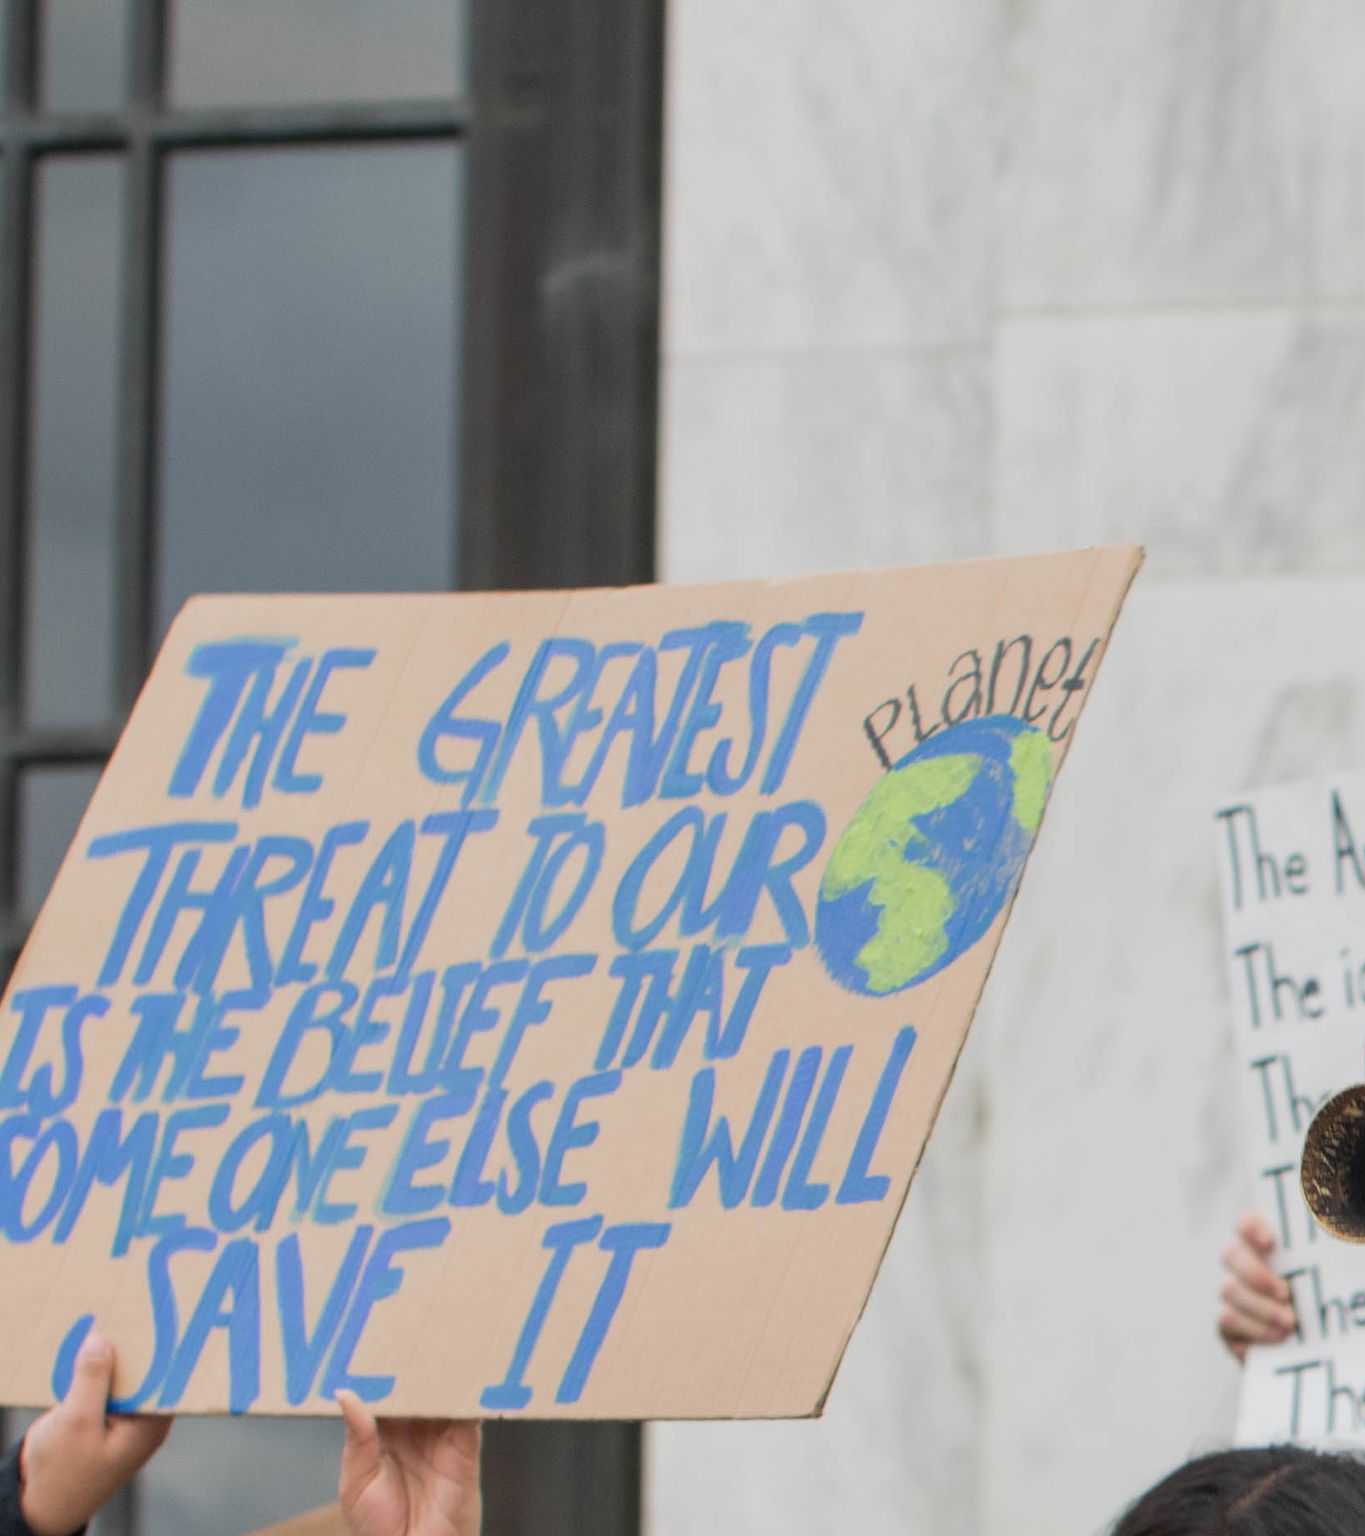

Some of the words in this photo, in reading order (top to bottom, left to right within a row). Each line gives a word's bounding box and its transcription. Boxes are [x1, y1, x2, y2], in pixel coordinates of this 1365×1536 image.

[167, 636, 378, 810] THE
[417, 612, 865, 809] GREATEST
[86, 808, 499, 993] THREAT
[489, 813, 606, 960] TO
[611, 799, 828, 954] OUR
[1216, 803, 1308, 909] The
[0, 984, 112, 1118] IS
[108, 990, 245, 1104] THE
[253, 953, 598, 1109] BELIEF
[594, 944, 793, 1071] THAT
[1235, 942, 1325, 1029] The
[376, 1067, 622, 1217] ELSE
[667, 1025, 917, 1210] WILL
[52, 1217, 452, 1414] SAVE
[480, 1214, 672, 1410] IT
